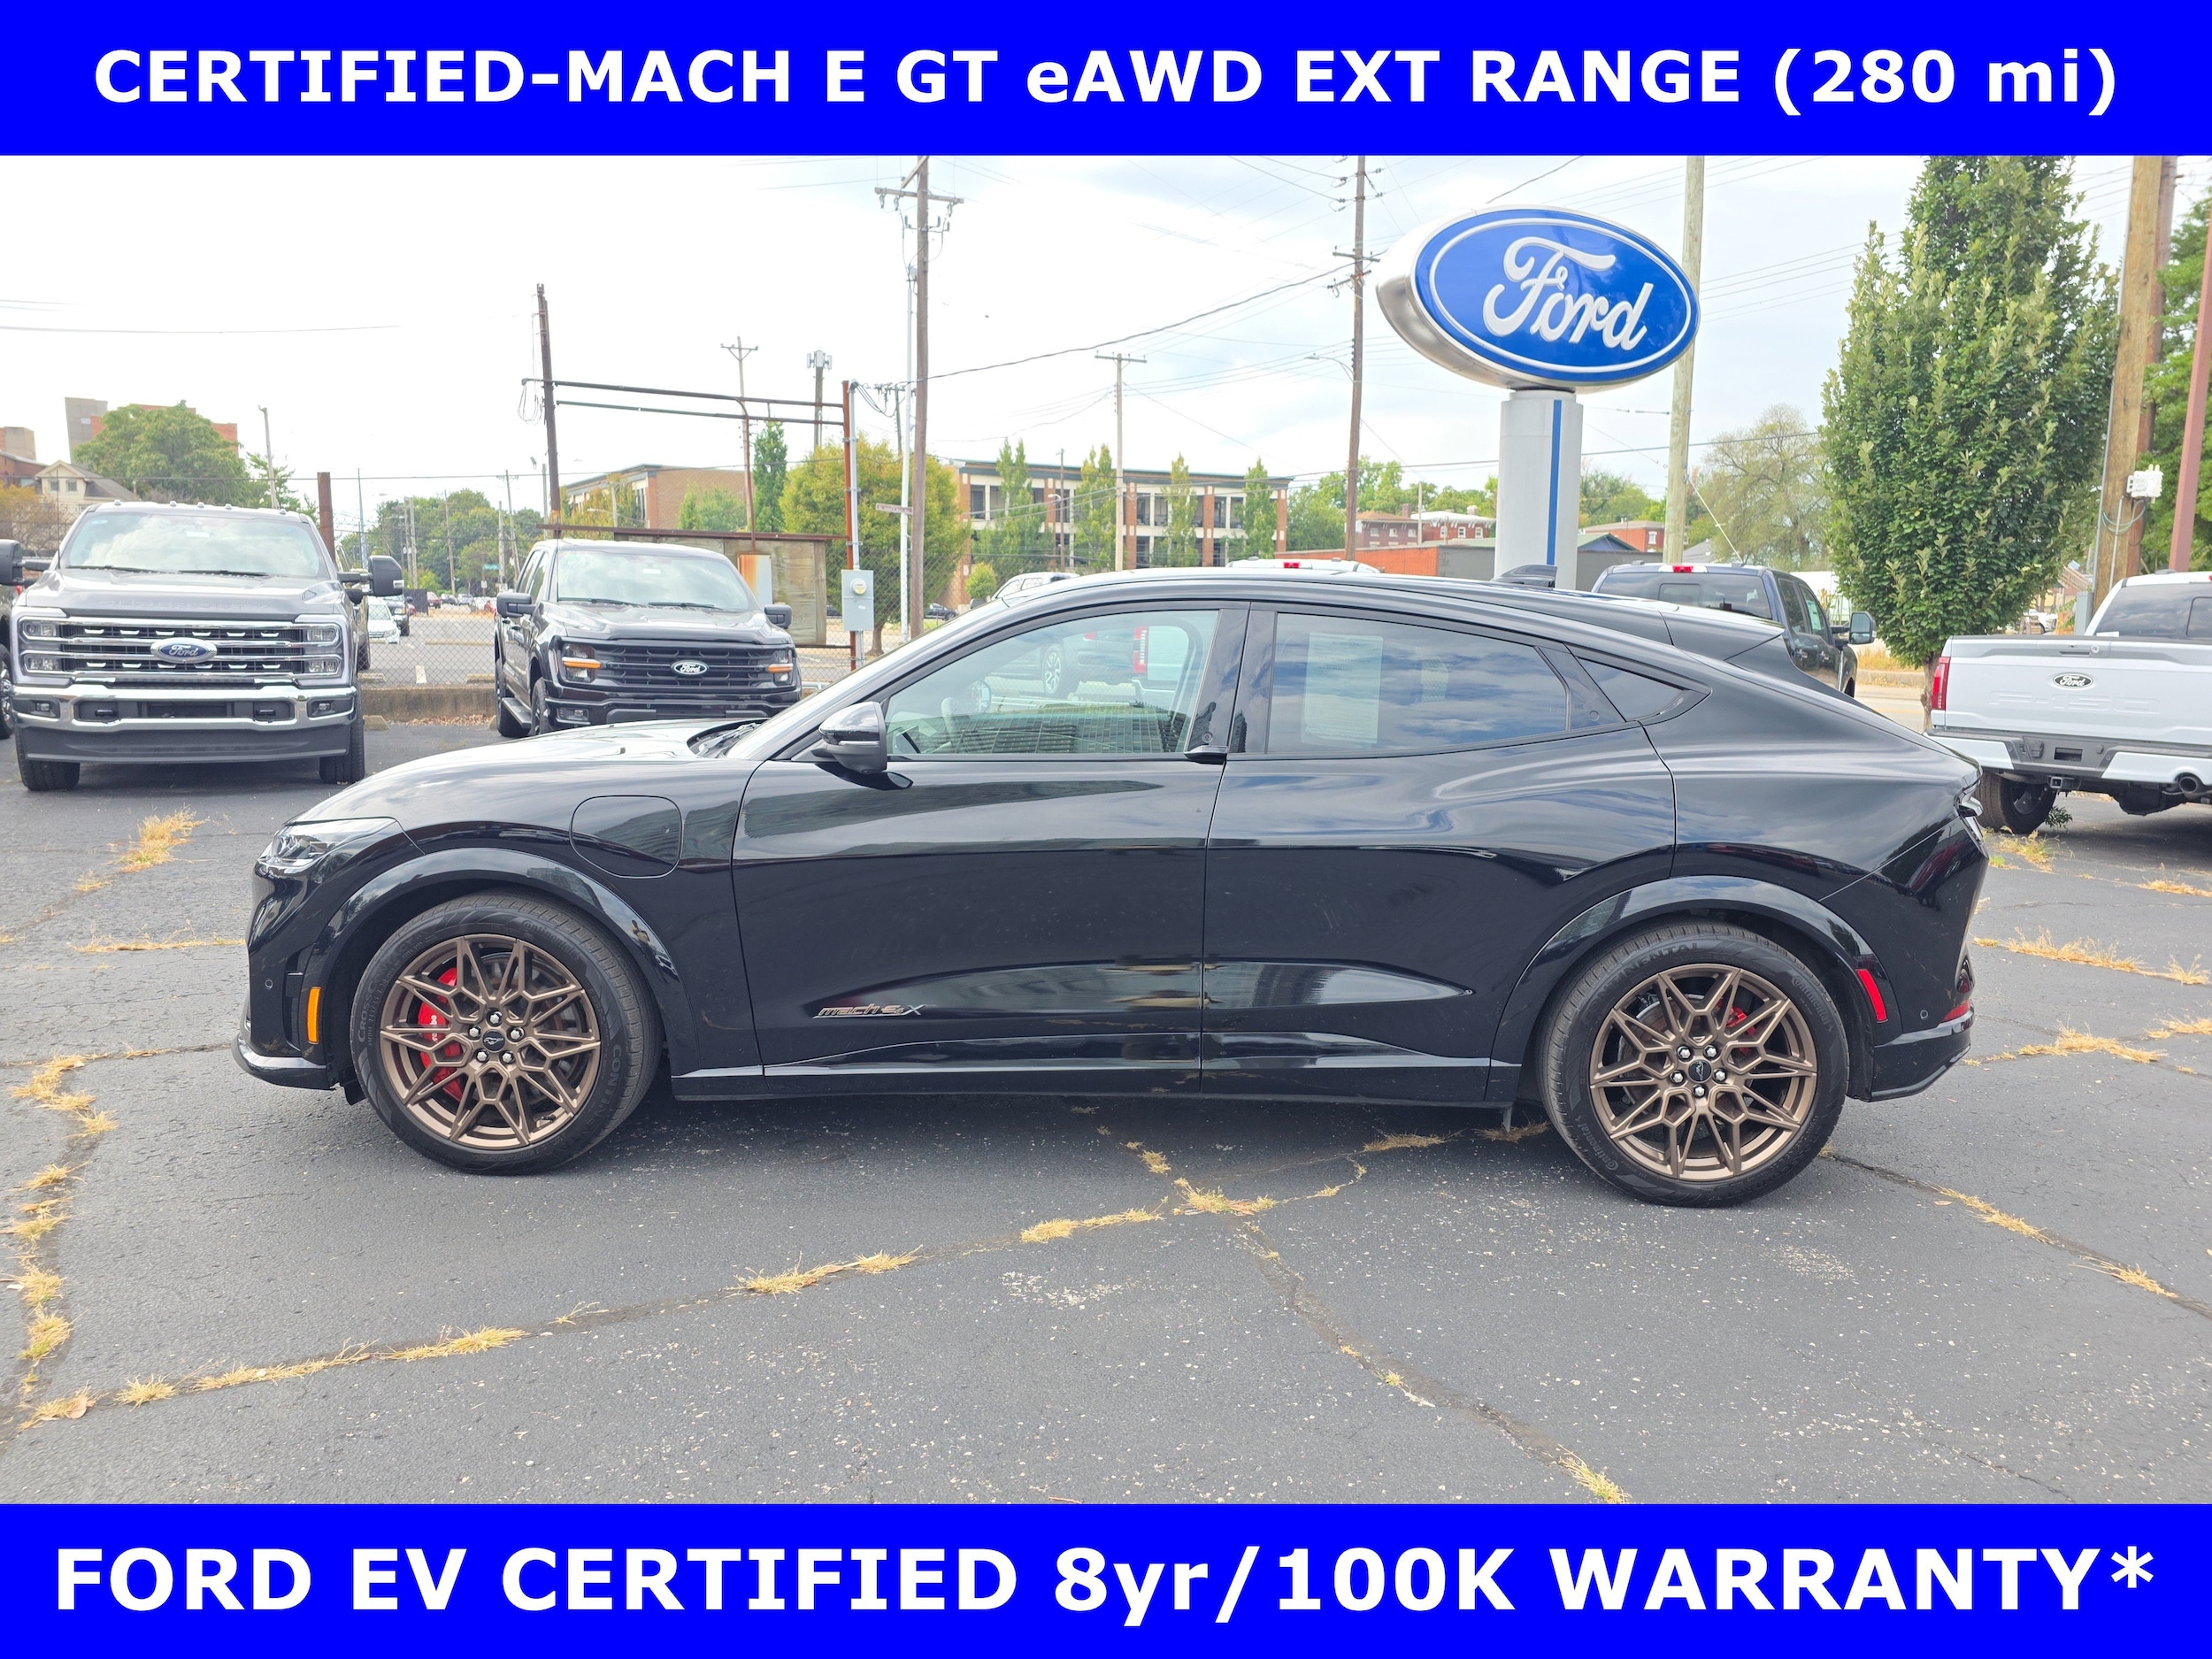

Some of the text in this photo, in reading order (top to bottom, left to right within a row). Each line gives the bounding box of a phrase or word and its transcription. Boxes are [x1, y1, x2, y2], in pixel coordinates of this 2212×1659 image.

[1483, 236, 1654, 350] Ford
[168, 644, 198, 657] Ford
[680, 664, 701, 673] Ford
[2059, 674, 2085, 687] Ford
[1988, 690, 2160, 715] F-150
